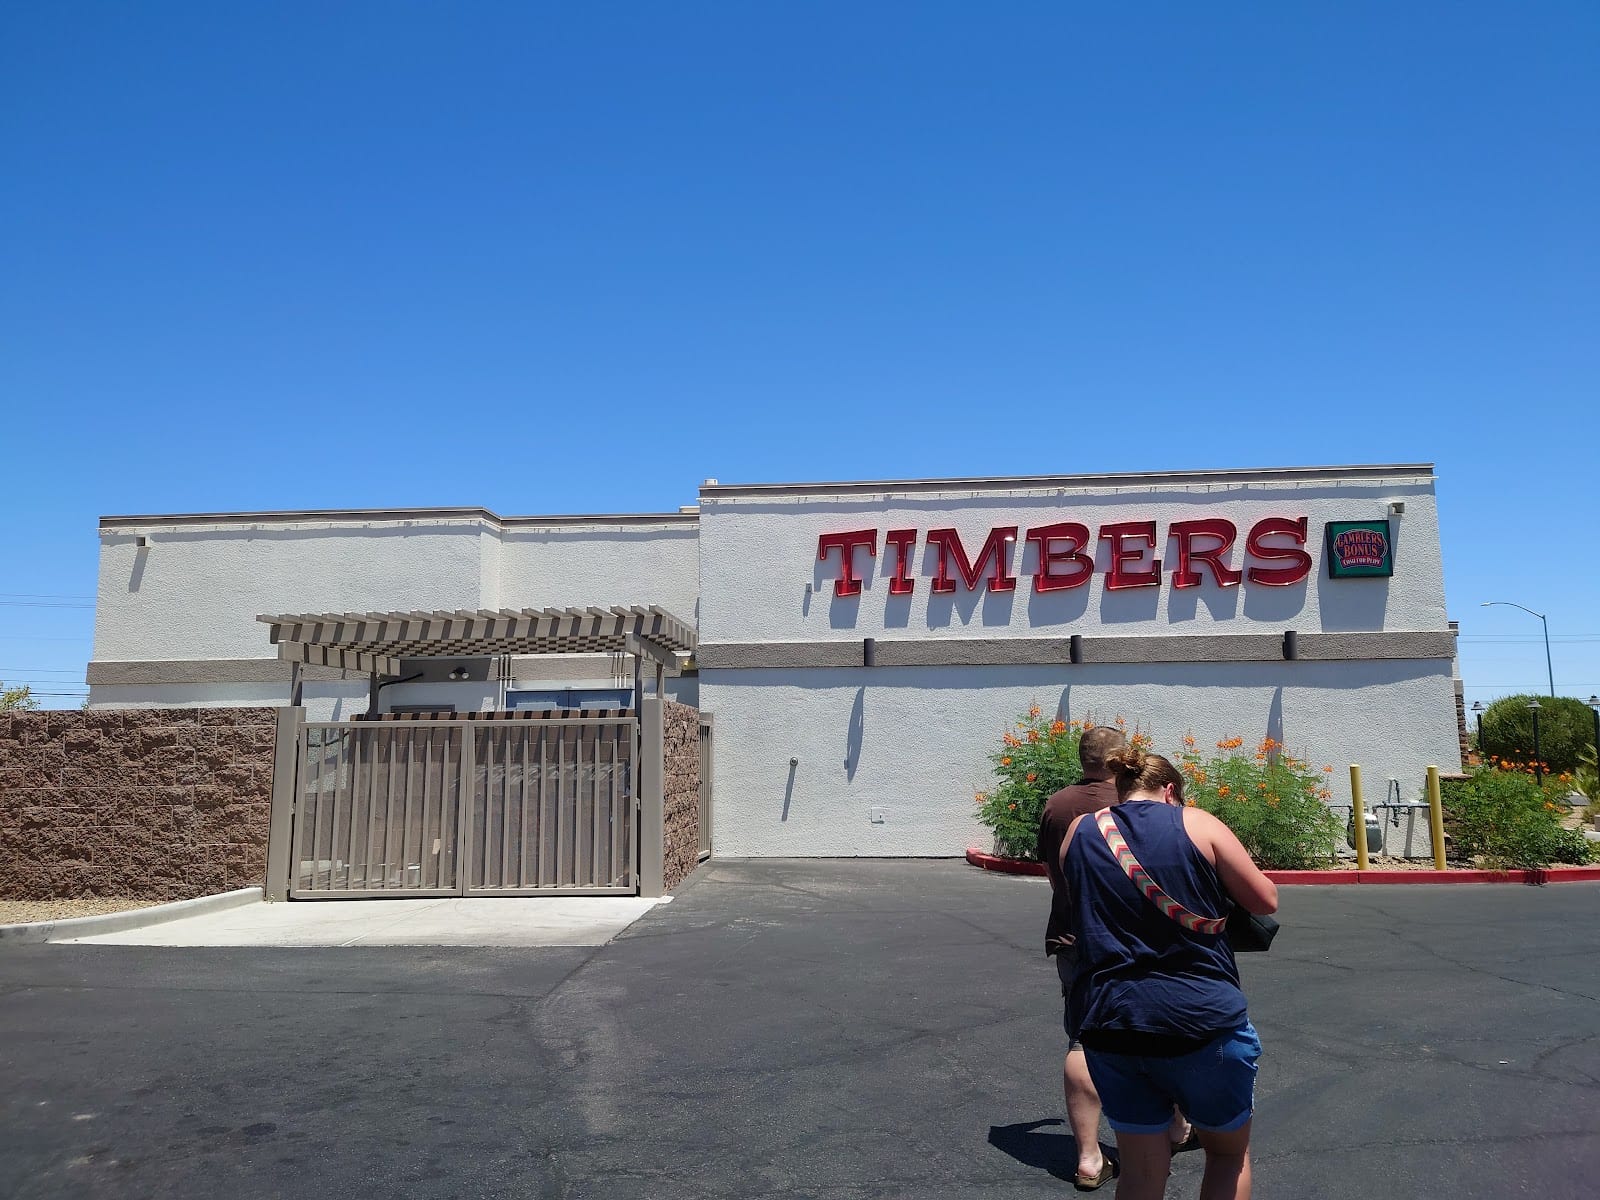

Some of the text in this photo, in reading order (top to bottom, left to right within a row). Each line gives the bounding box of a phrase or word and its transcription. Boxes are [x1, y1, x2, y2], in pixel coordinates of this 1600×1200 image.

[1337, 531, 1383, 548] GAMBLERS
[819, 517, 1313, 597] TIMBERS
[1344, 543, 1378, 558] BONUS
